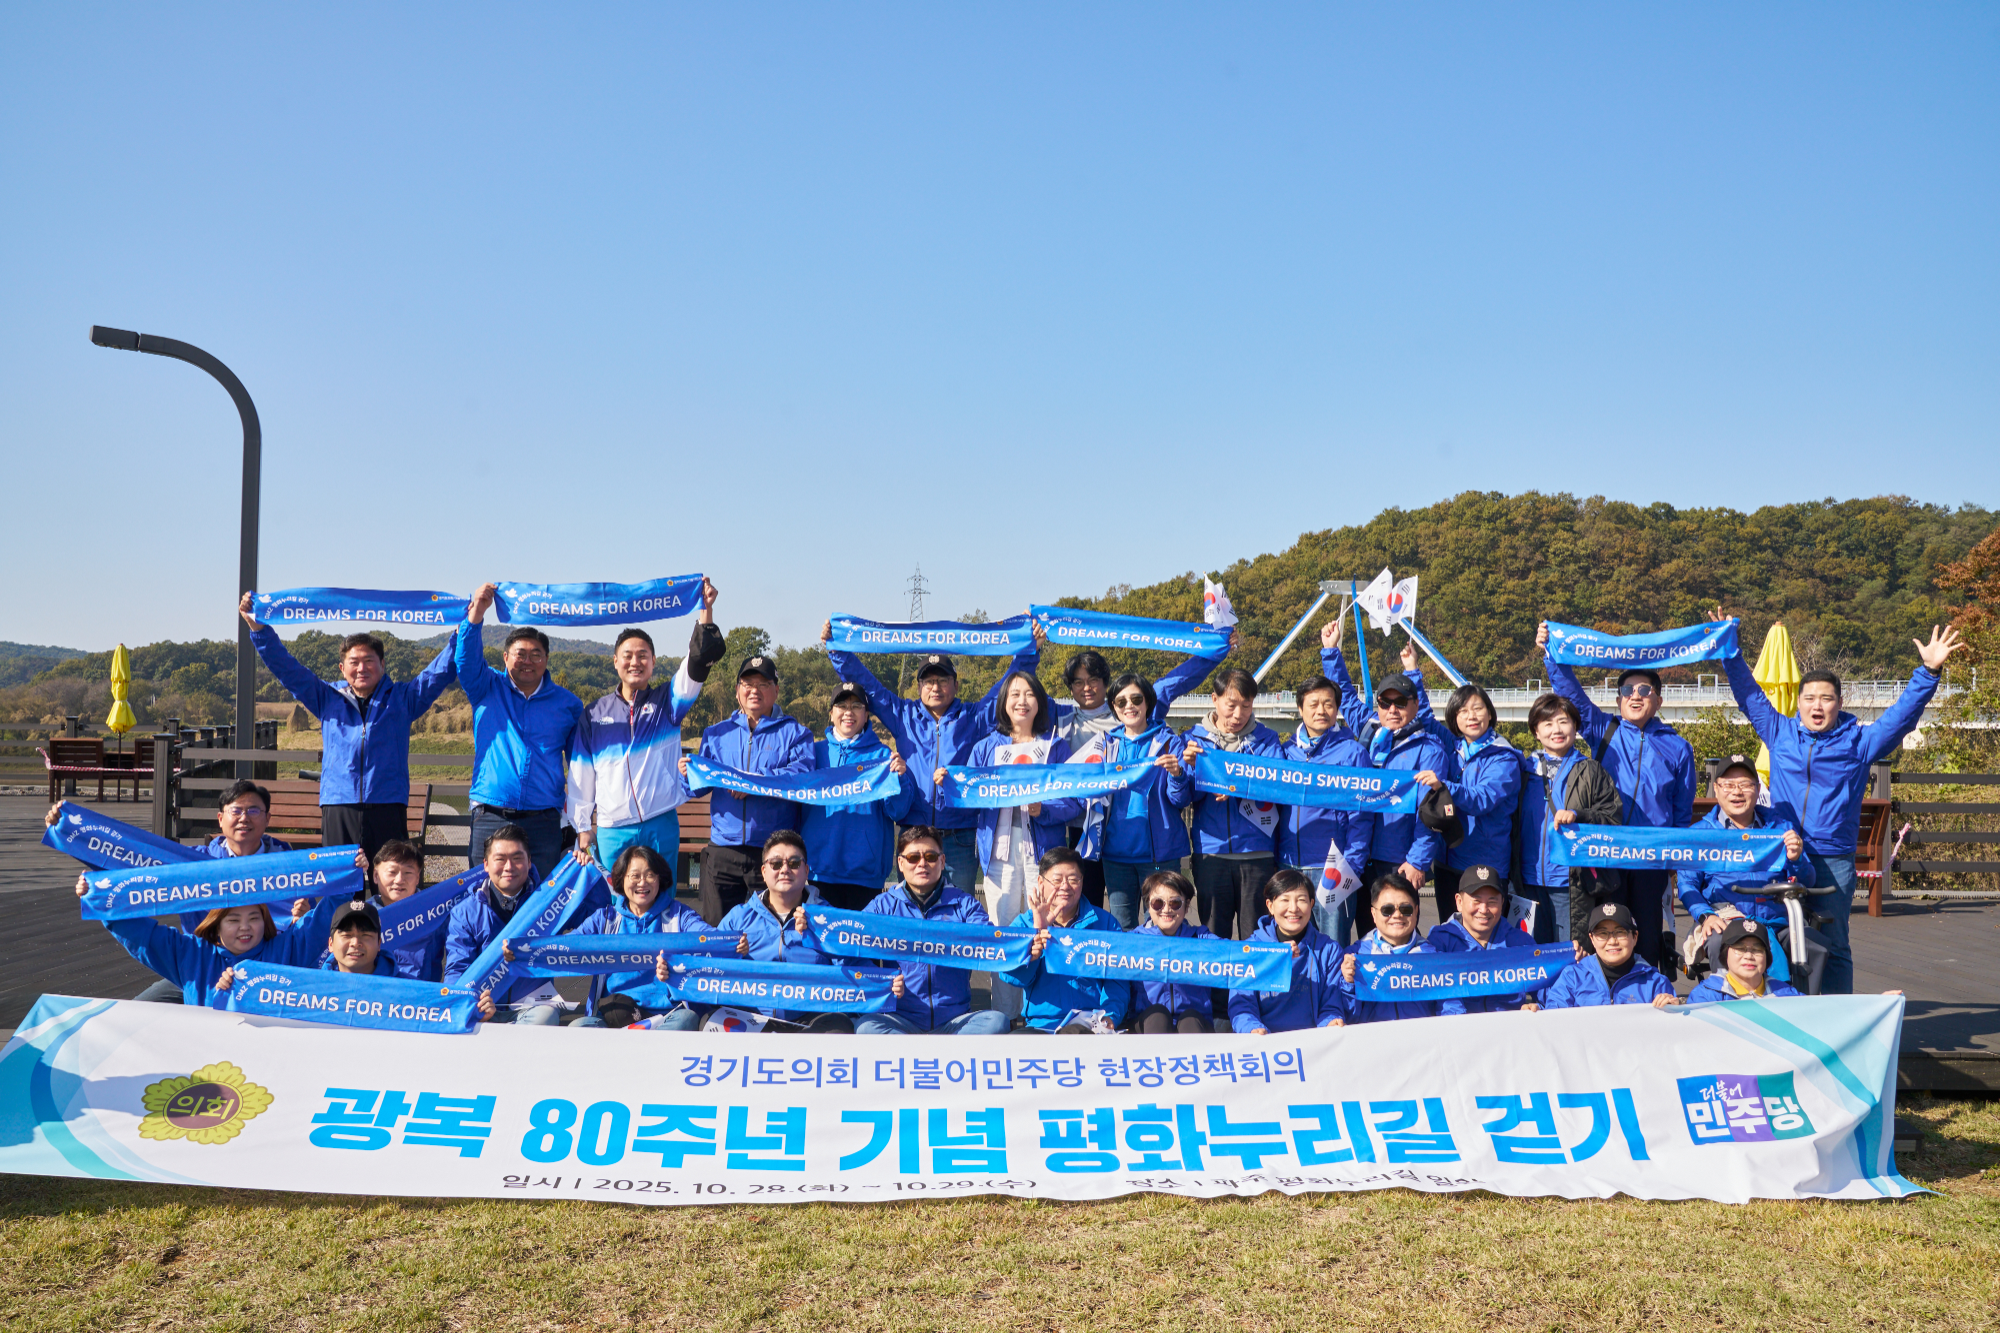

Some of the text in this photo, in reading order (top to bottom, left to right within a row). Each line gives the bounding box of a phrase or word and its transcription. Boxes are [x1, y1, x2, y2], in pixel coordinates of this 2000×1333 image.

[284, 608, 445, 623] DREAMS FOR KOREA
[529, 595, 682, 616] DREAMS FOR KOREA
[862, 631, 1010, 645] DREAMS FOR KOREA
[1058, 627, 1203, 649] DREAMS FOR KOREA
[1575, 638, 1717, 660] DREAMS FOR KOREA
[1224, 761, 1381, 791] DREAMS FOR KOREA
[721, 778, 872, 800] DREAMS FOR KOREA
[979, 779, 1128, 798] DREAMS FOR KOREA
[1588, 844, 1755, 863] DREAMS FOR KOREA
[128, 870, 327, 905] DREAMS FOR KOREA
[145, 875, 159, 884] 걷기
[535, 887, 577, 931] KOREA
[397, 914, 424, 936] FOR
[838, 931, 1007, 962] DREAMS FOR KOREA
[546, 954, 653, 965] DREAMS FOR
[1085, 951, 1256, 978] DREAMS FOR KOREA
[235, 974, 292, 1001] DMZ 평화누리길 걷기
[1390, 966, 1548, 990] DREAMS FOR KOREA
[697, 978, 867, 1002] DREAMS FOR KOREA
[259, 987, 452, 1023] DREAMS FOR KOREA
[680, 1047, 1306, 1091] 경기도의회 더불어민주당 현장정책회의
[1699, 1080, 1744, 1102] 더불어
[169, 1093, 235, 1121] 의회
[1686, 1096, 1804, 1138] 민주당
[309, 1087, 1652, 1175] 광복 80주년 기념 평화누리길 걷기
[502, 1175, 562, 1189] 일시
[593, 1178, 679, 1194] 2025.
[692, 1183, 736, 1195] 10.
